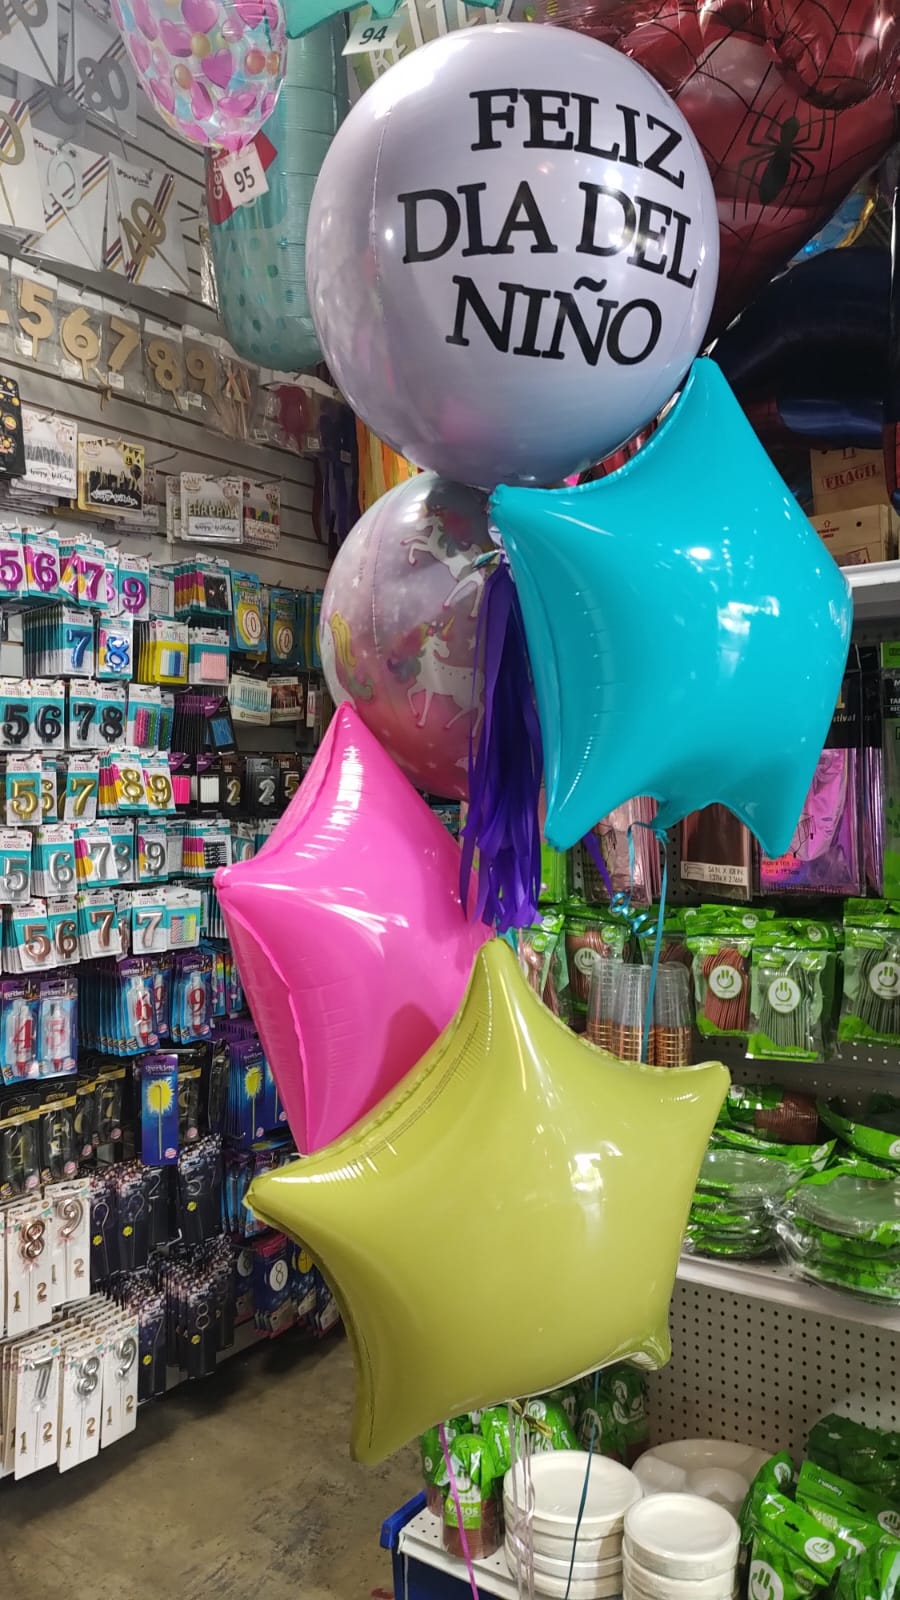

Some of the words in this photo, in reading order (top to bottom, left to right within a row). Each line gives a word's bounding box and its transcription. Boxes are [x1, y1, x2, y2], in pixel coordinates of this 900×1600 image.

[358, 25, 389, 46] 94
[469, 88, 685, 189] FELIZ
[233, 166, 256, 193] 95
[397, 180, 559, 265] DIA
[575, 181, 698, 289] DEL
[18, 279, 55, 350] 5
[445, 275, 662, 366] NIÑO
[62, 307, 100, 368] 6
[108, 316, 141, 371] 7
[147, 340, 183, 394] 8
[186, 341, 217, 398] 9
[0, 549, 23, 592] 5
[33, 552, 58, 592] 6
[83, 560, 105, 601] 7
[121, 577, 147, 613] 9
[66, 628, 92, 669] 7
[105, 635, 130, 673] 8
[3, 703, 30, 744] 5
[34, 704, 61, 743] 6
[73, 702, 96, 741] 7
[100, 706, 123, 743] 8
[12, 778, 39, 820] 5
[71, 778, 97, 817] 7
[119, 767, 145, 804] 8
[149, 773, 172, 809] 9
[226, 778, 241, 806] 2
[258, 778, 276, 805] 2
[284, 773, 300, 800] 5
[50, 851, 75, 889] 6
[87, 842, 111, 881] 7
[113, 841, 131, 878] 8
[144, 840, 166, 876] 9
[4, 857, 28, 898] 5
[23, 924, 51, 962] 5
[55, 919, 77, 958] 6
[90, 911, 115, 948] 7
[137, 911, 163, 949] 7
[189, 987, 205, 1013] 9
[12, 1019, 33, 1049] 4
[57, 1199, 83, 1237] 9
[19, 1219, 45, 1261] 8
[73, 1258, 85, 1278] 2
[13, 1290, 21, 1312] 1
[36, 1282, 48, 1302] 2
[76, 1356, 100, 1396] 8
[116, 1337, 137, 1377] 9
[30, 1357, 54, 1400] 7
[106, 1406, 113, 1426] 1
[125, 1394, 134, 1413] 2
[20, 1431, 27, 1455] 1
[43, 1421, 53, 1443] 2
[65, 1426, 72, 1448] 1
[86, 1416, 96, 1437] 2
